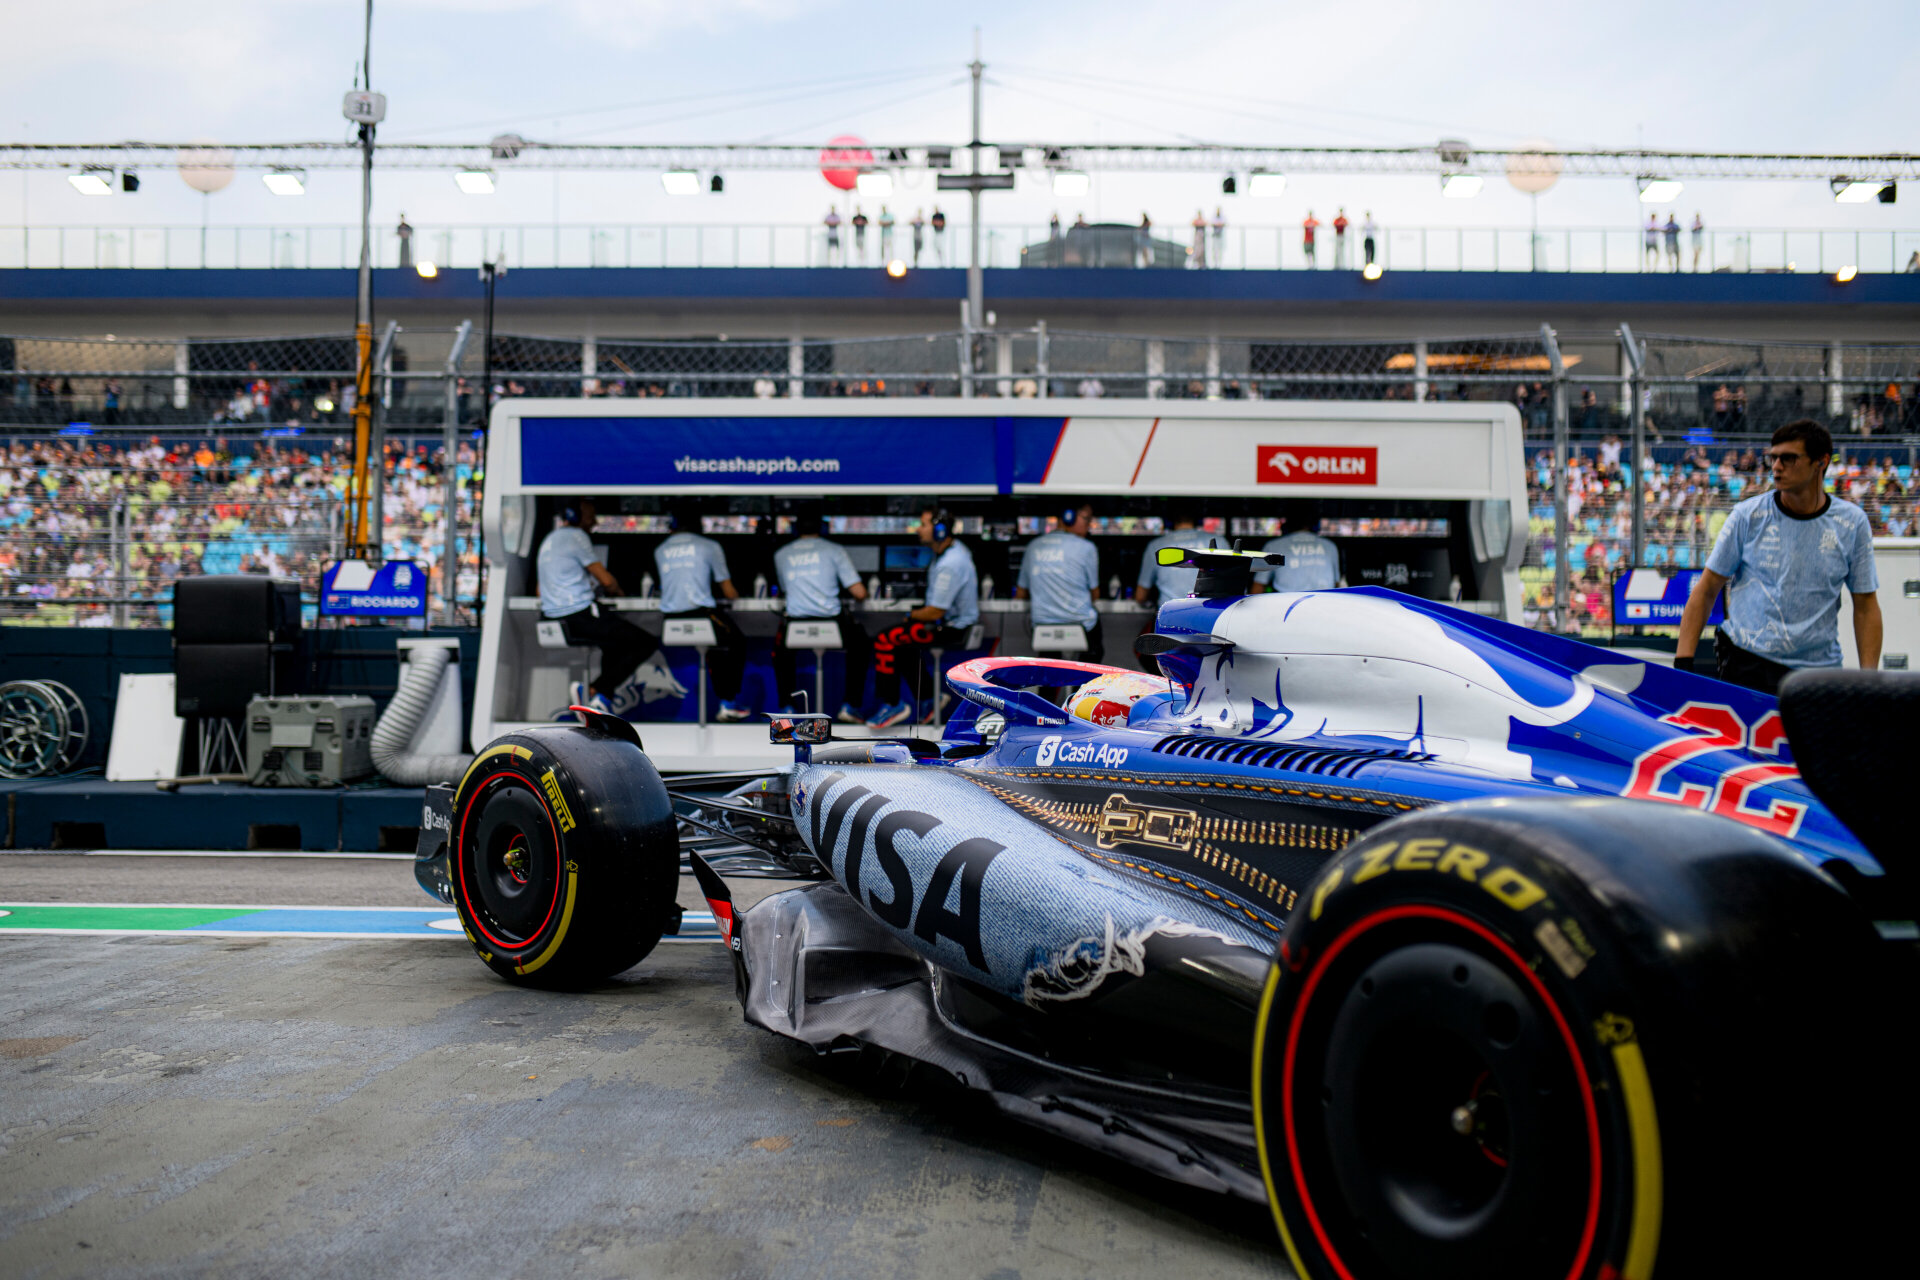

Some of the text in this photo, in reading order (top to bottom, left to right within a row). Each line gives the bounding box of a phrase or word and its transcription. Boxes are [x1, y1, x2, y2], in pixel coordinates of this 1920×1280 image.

[674, 455, 839, 475] visacashapprb.com
[1302, 456, 1366, 475] ORLEN
[664, 544, 696, 559] VISA
[788, 552, 820, 567] VISA
[1034, 549, 1064, 562] VISA
[1290, 544, 1325, 556] VISA
[350, 596, 419, 608] RICCIARDO
[1058, 741, 1128, 769] Cash App
[1621, 702, 1808, 839] 22
[540, 770, 576, 833] PIRELLI
[432, 812, 444, 829] Cash
[810, 770, 1006, 974] VISA
[1352, 838, 1547, 911] ZERO
